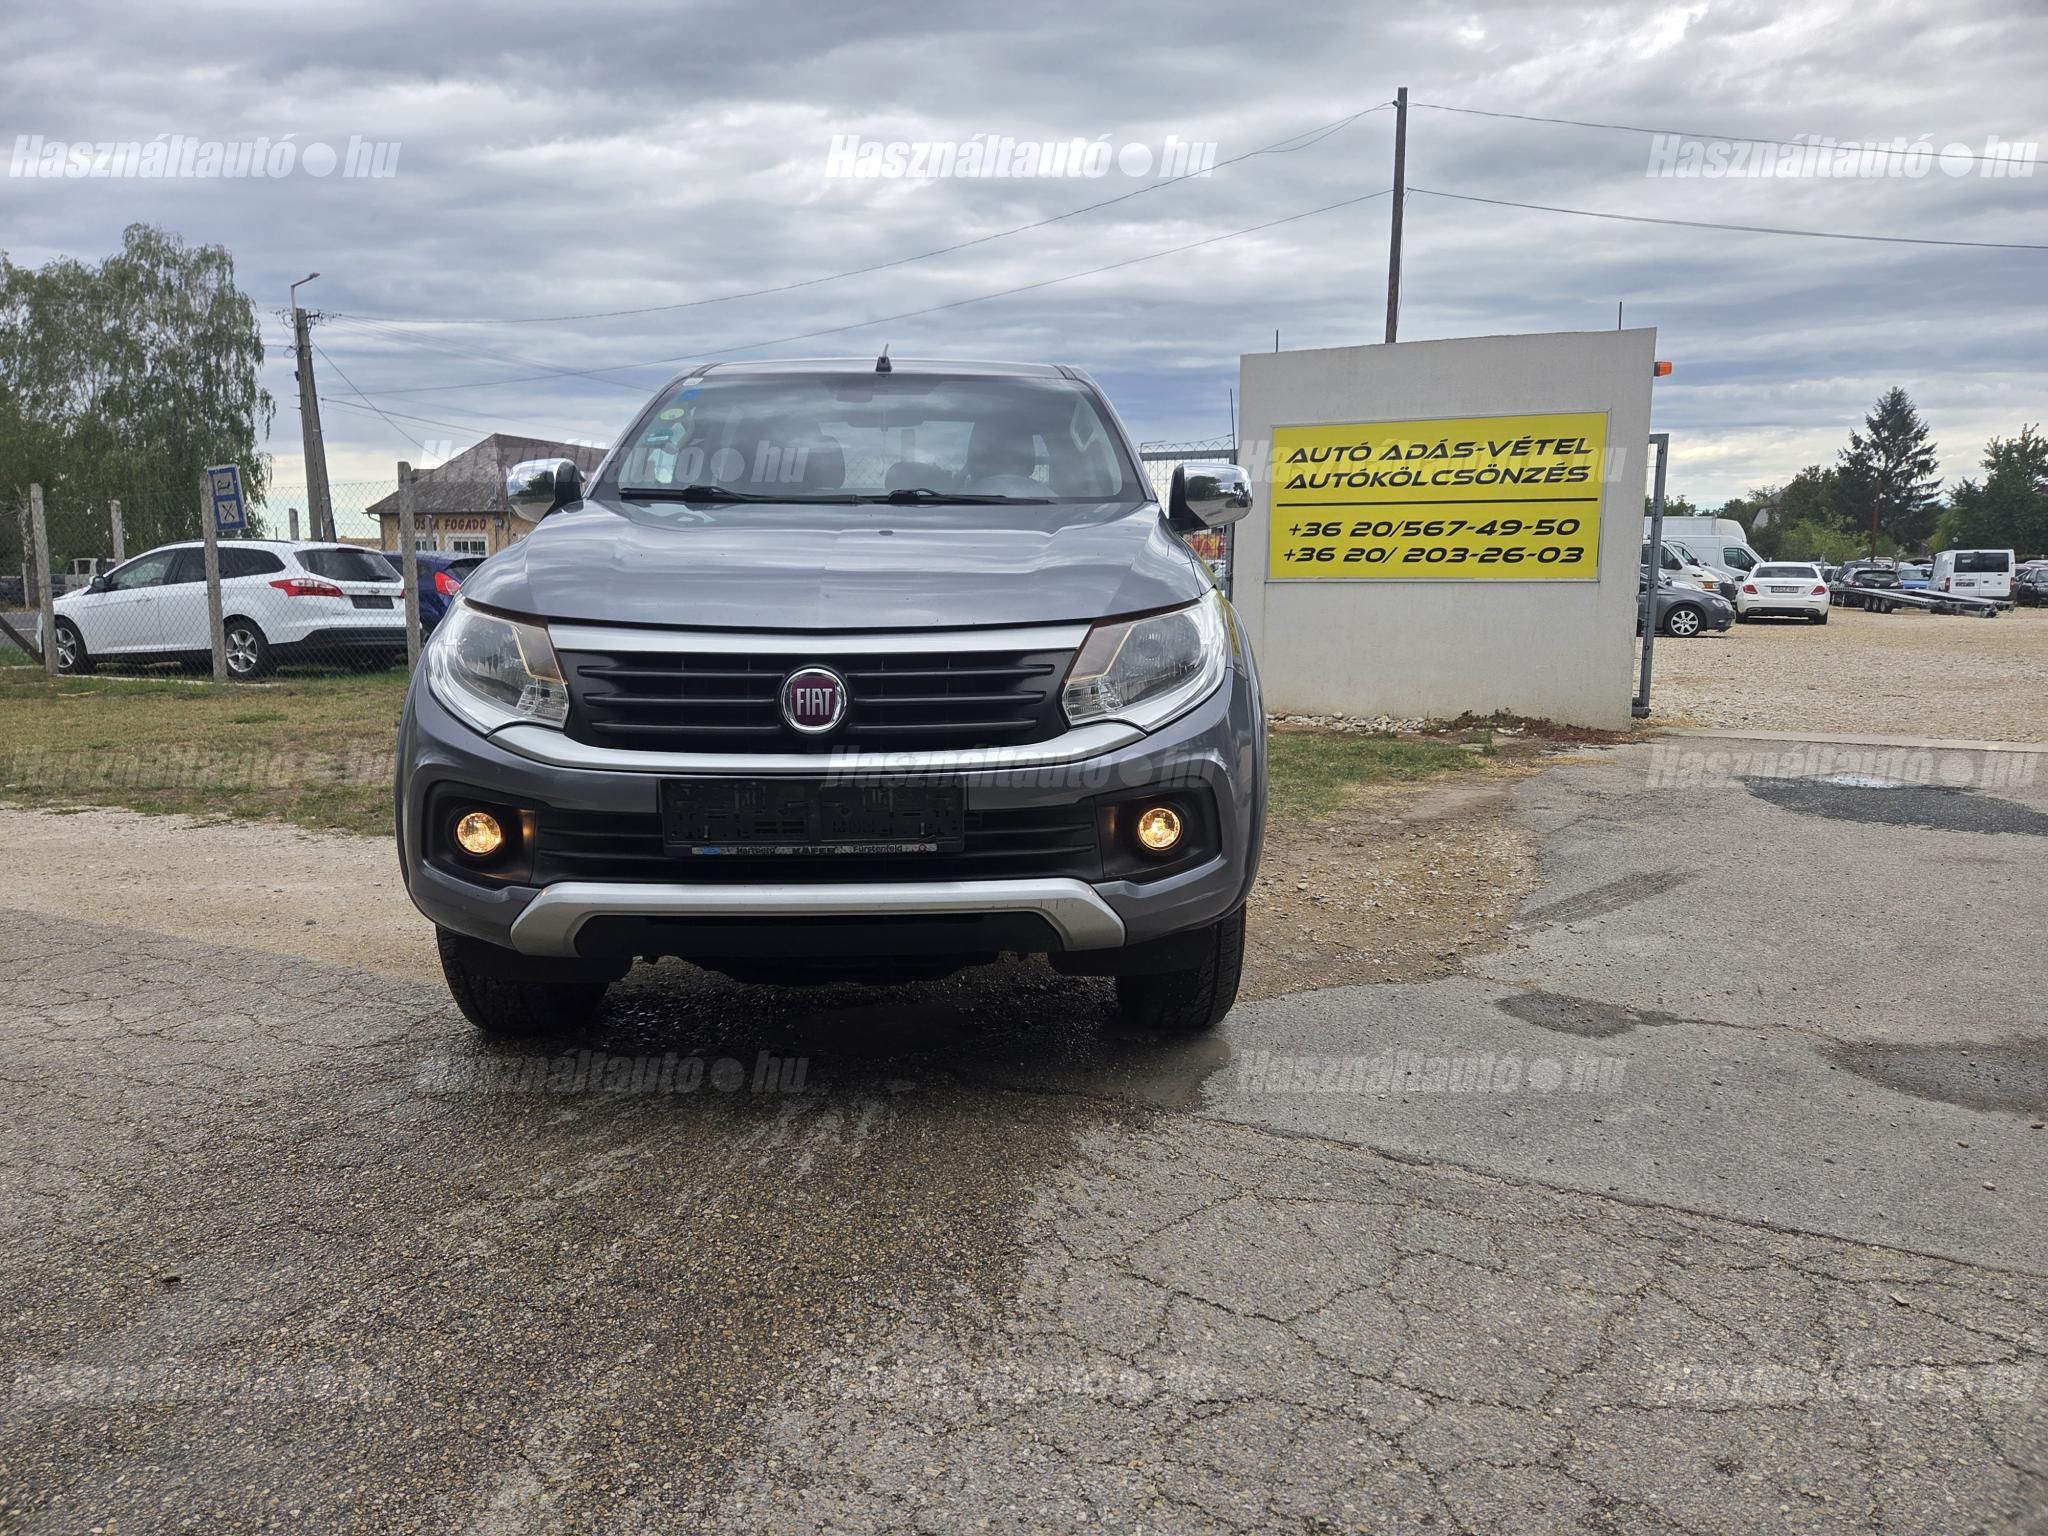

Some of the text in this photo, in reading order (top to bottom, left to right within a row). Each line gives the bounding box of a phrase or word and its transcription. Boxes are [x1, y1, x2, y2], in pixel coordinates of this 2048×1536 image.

[1286, 436, 1593, 464] AUTÓ ADÁS-VÉTEL
[1284, 462, 1592, 489] AUTÓKÖLCSÖNZÉS
[1289, 518, 1580, 537] +36 20/567-49-50
[1283, 546, 1585, 564] +36 20/ 203-26-03
[796, 688, 833, 716] FIAT
